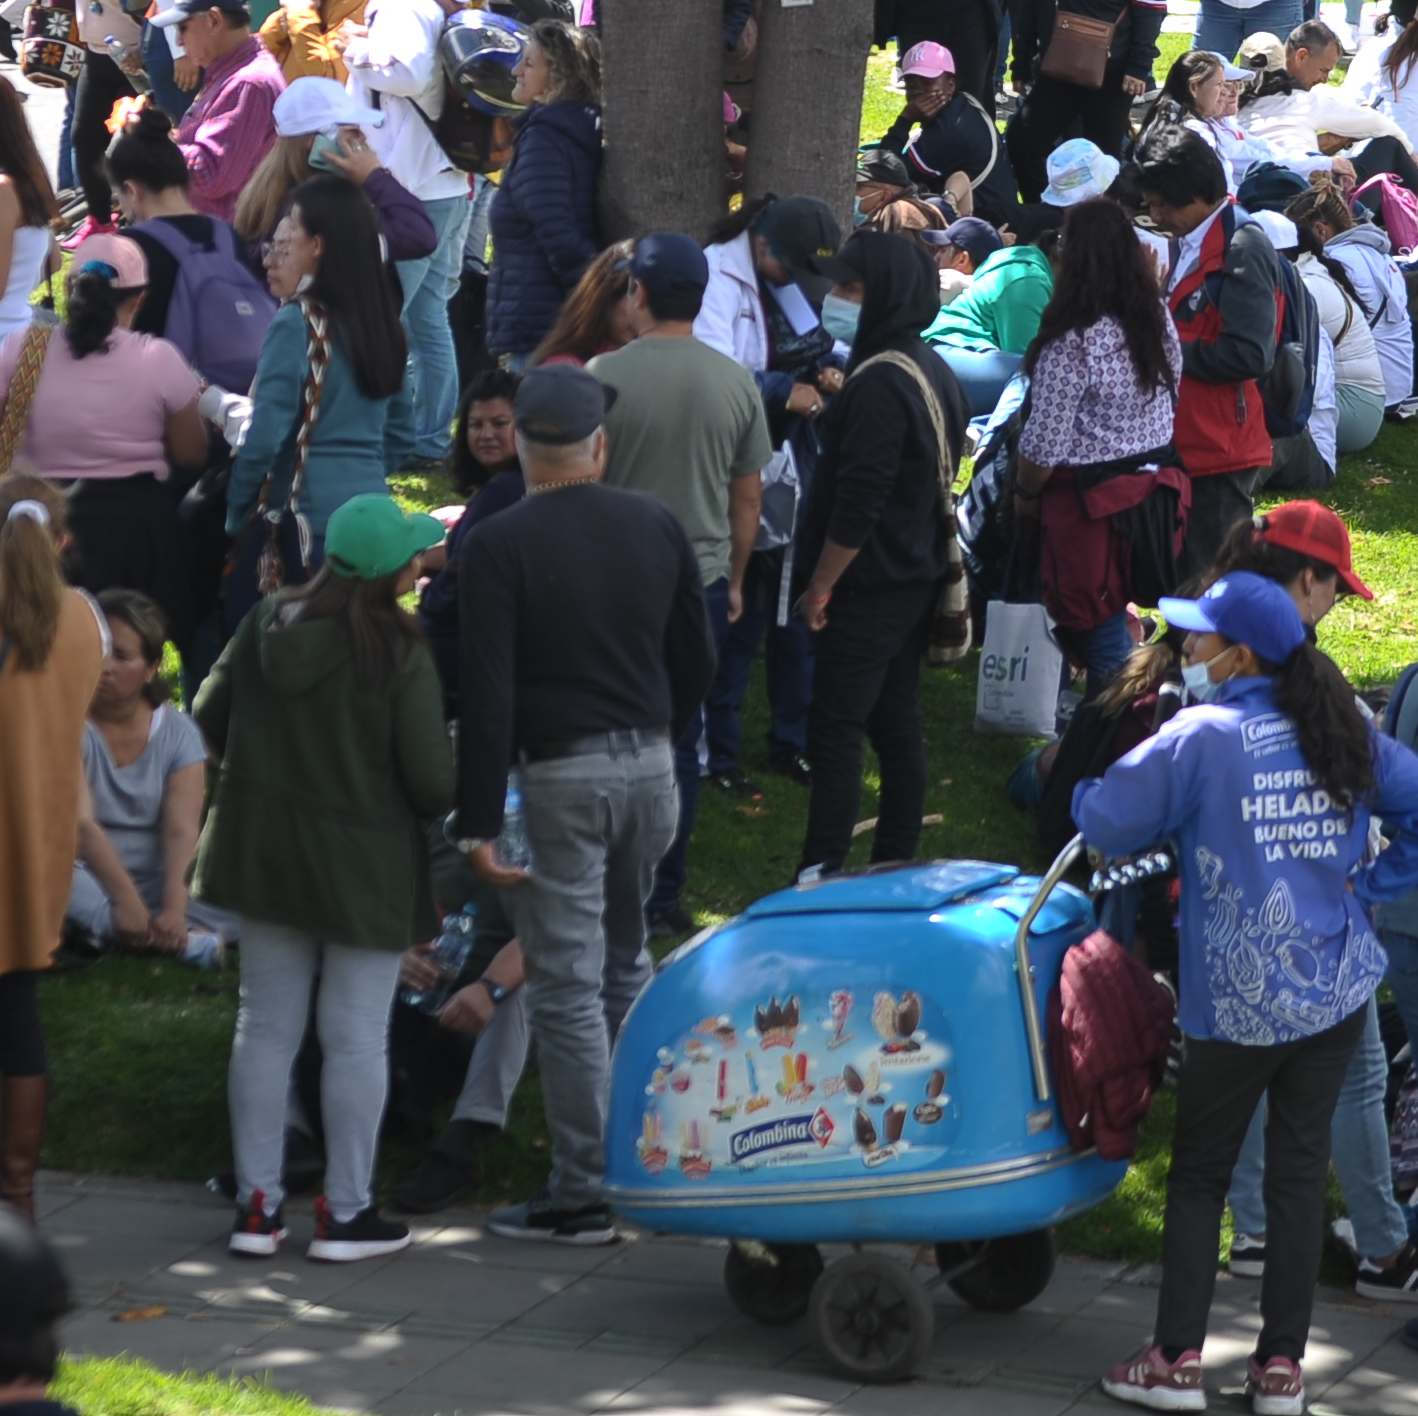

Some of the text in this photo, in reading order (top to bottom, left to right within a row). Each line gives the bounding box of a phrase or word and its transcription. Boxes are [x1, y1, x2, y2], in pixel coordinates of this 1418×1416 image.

[982, 645, 1030, 682] esri
[1247, 717, 1297, 742] Colomb
[1253, 769, 1319, 791] DISFRU
[1254, 817, 1348, 844] BUENO DE
[1265, 839, 1339, 863] LA VIDA
[733, 1122, 808, 1156] Colombina
